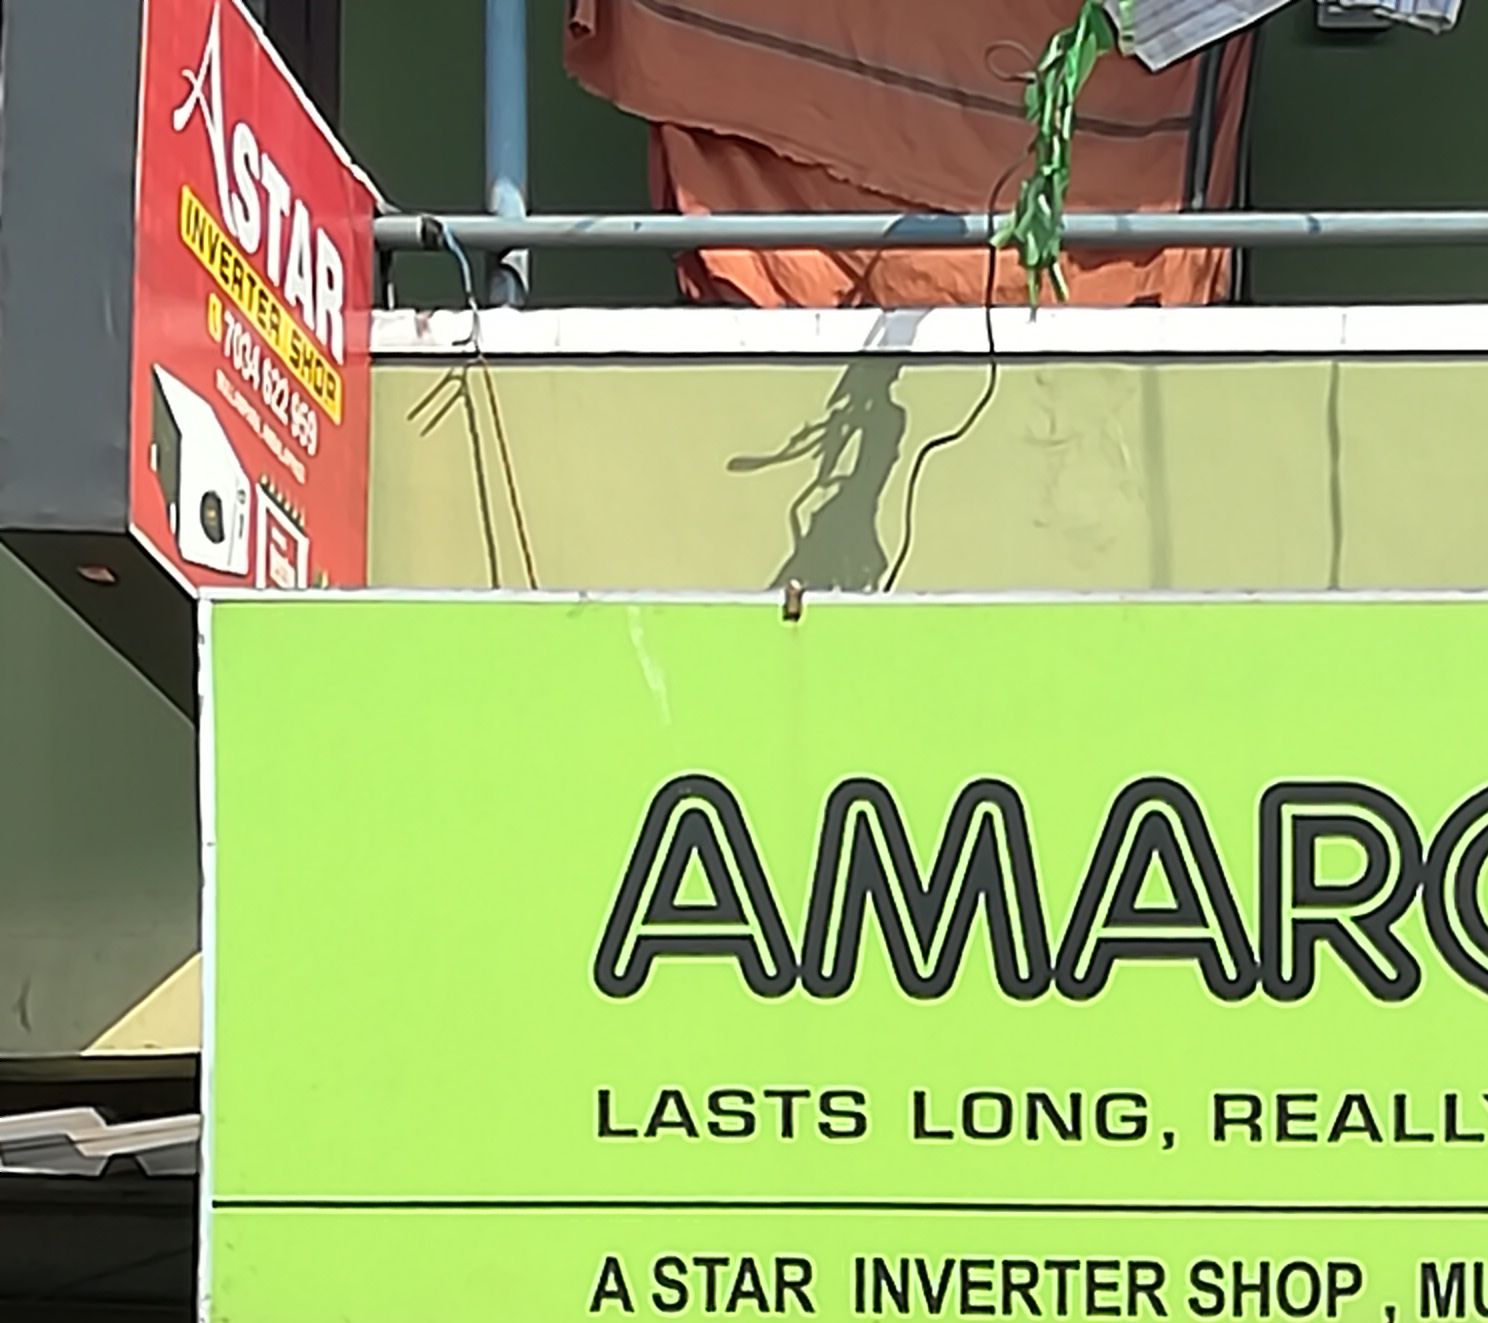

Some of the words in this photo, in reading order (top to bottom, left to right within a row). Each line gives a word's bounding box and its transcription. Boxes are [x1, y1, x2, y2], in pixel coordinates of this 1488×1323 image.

[185, 199, 284, 346] INVERTER
[288, 327, 339, 403] SHOP
[229, 121, 345, 365] STAR
[596, 1088, 868, 1140] LASTS
[912, 1089, 1176, 1152] LONG,
[588, 1256, 636, 1314] A
[652, 1256, 817, 1315] STAR
[854, 1257, 1169, 1318] INVERTER
[1187, 1259, 1364, 1320] SHOP
